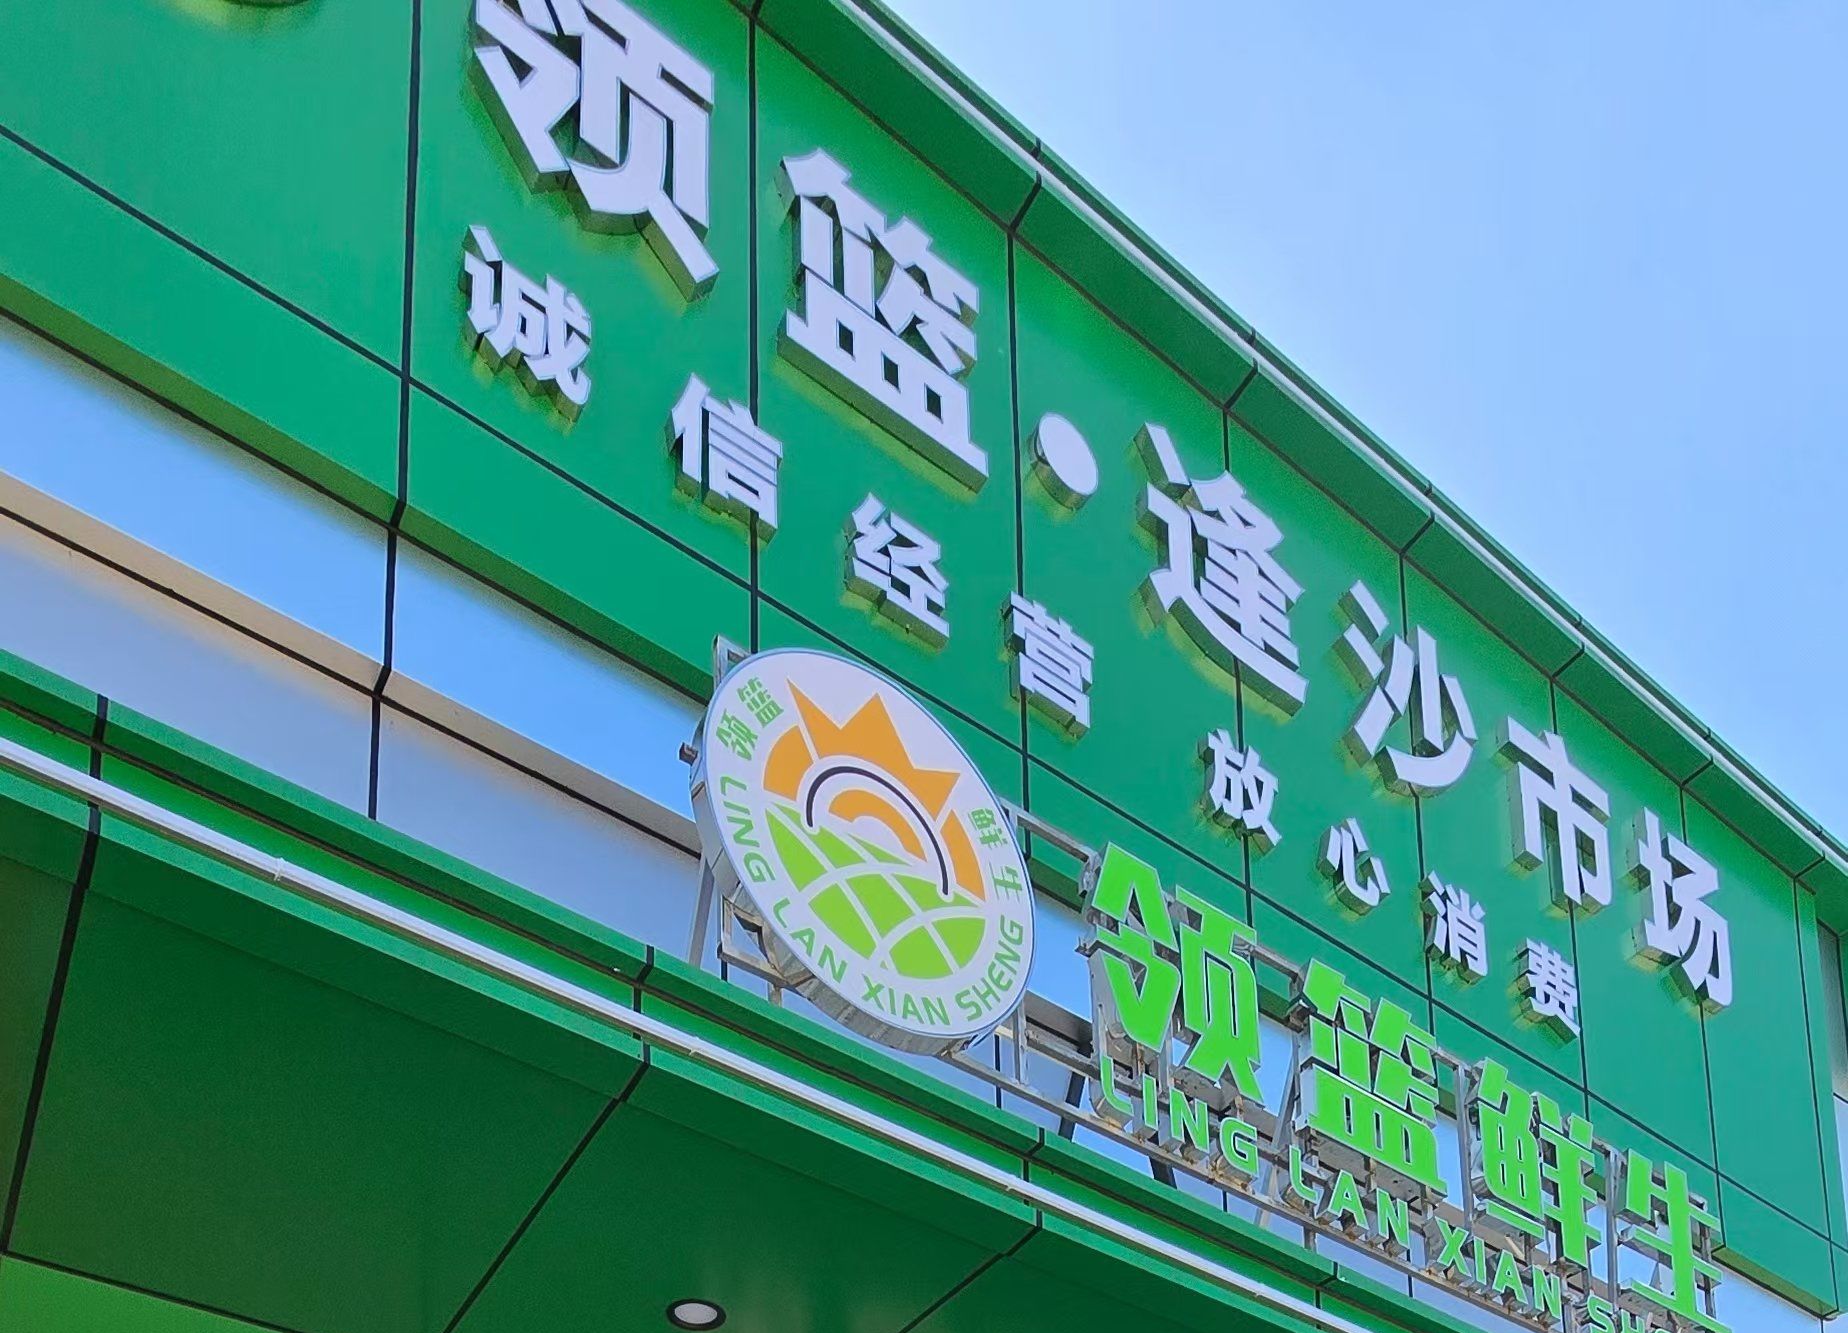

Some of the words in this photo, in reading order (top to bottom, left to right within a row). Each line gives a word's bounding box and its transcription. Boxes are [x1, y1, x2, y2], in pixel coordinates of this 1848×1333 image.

[463, 225, 1095, 734] 诚信经营
[1203, 729, 1582, 1041] 放心消费
[719, 774, 777, 884] LING
[771, 896, 848, 983] LAN
[861, 972, 952, 1027] XIAN
[957, 914, 1025, 1023] SHENG
[1099, 1053, 1261, 1183] LING
[1288, 1144, 1412, 1251] LAN
[1437, 1217, 1563, 1323] XIAN
